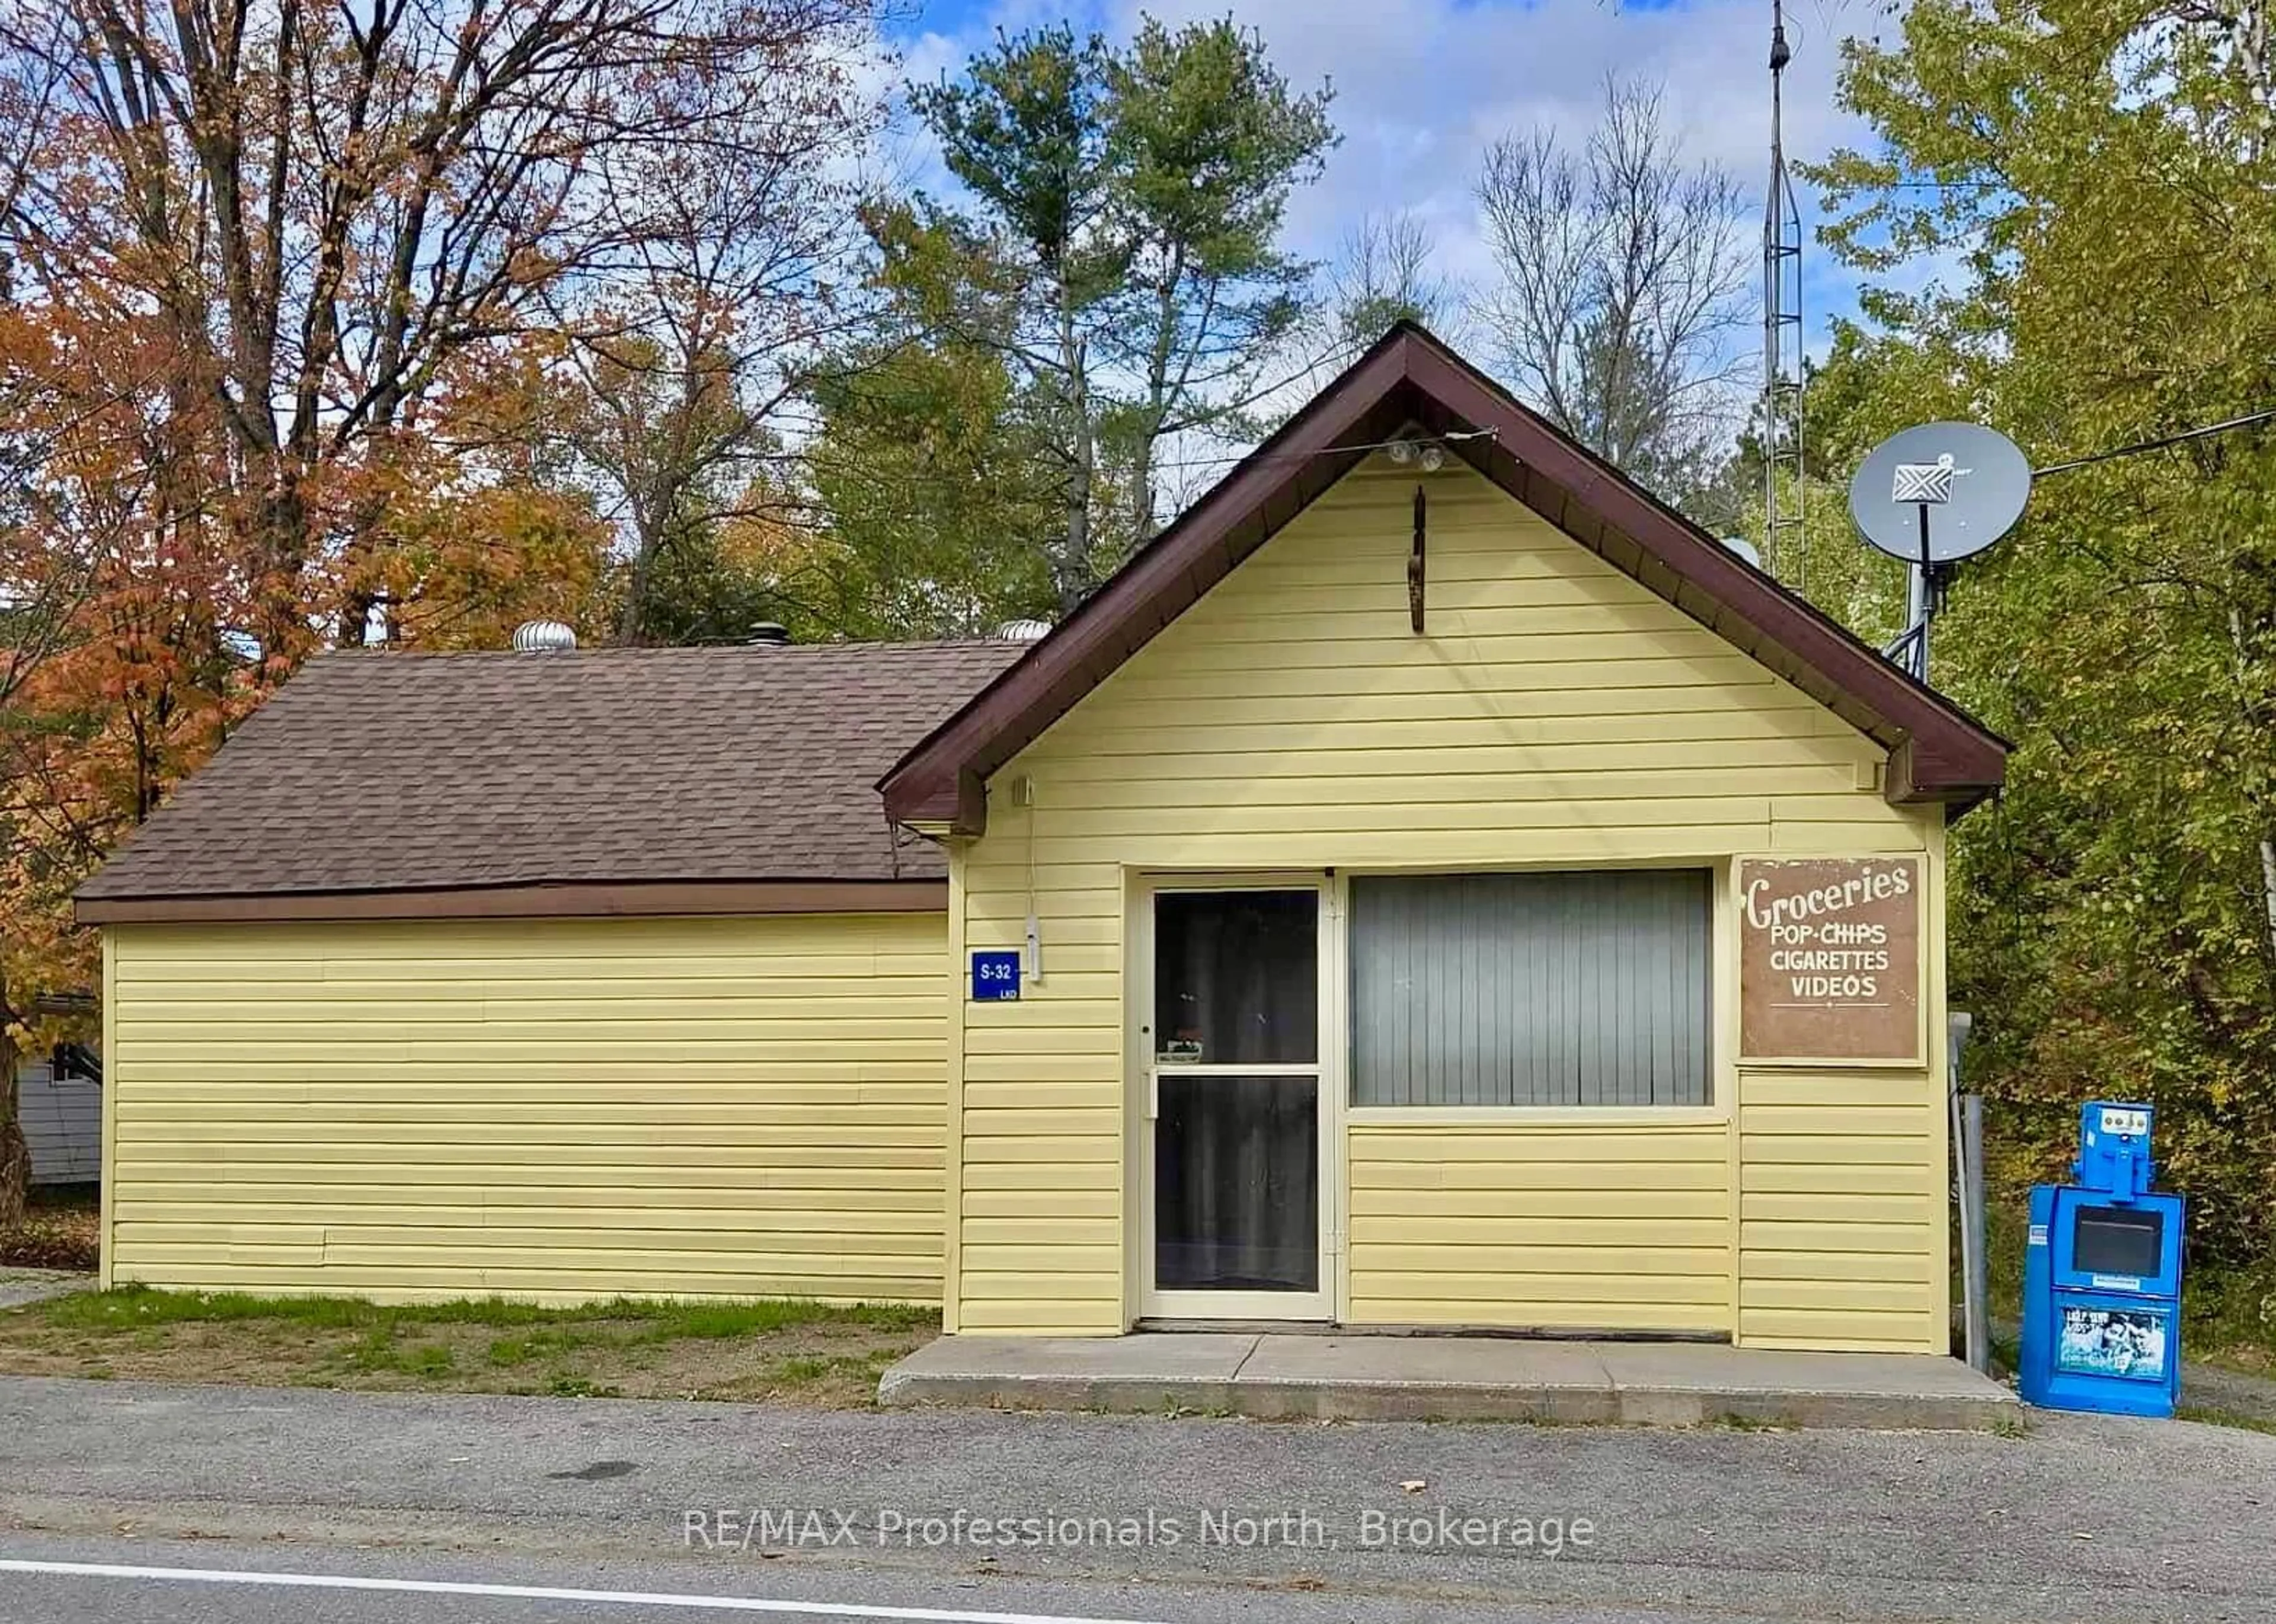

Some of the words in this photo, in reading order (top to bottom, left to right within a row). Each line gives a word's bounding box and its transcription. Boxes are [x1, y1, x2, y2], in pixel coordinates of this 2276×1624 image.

[1748, 867, 1909, 928] Groceries
[1770, 951, 1889, 970] CIGARETTES
[1791, 977, 1878, 996] VIDEOS
